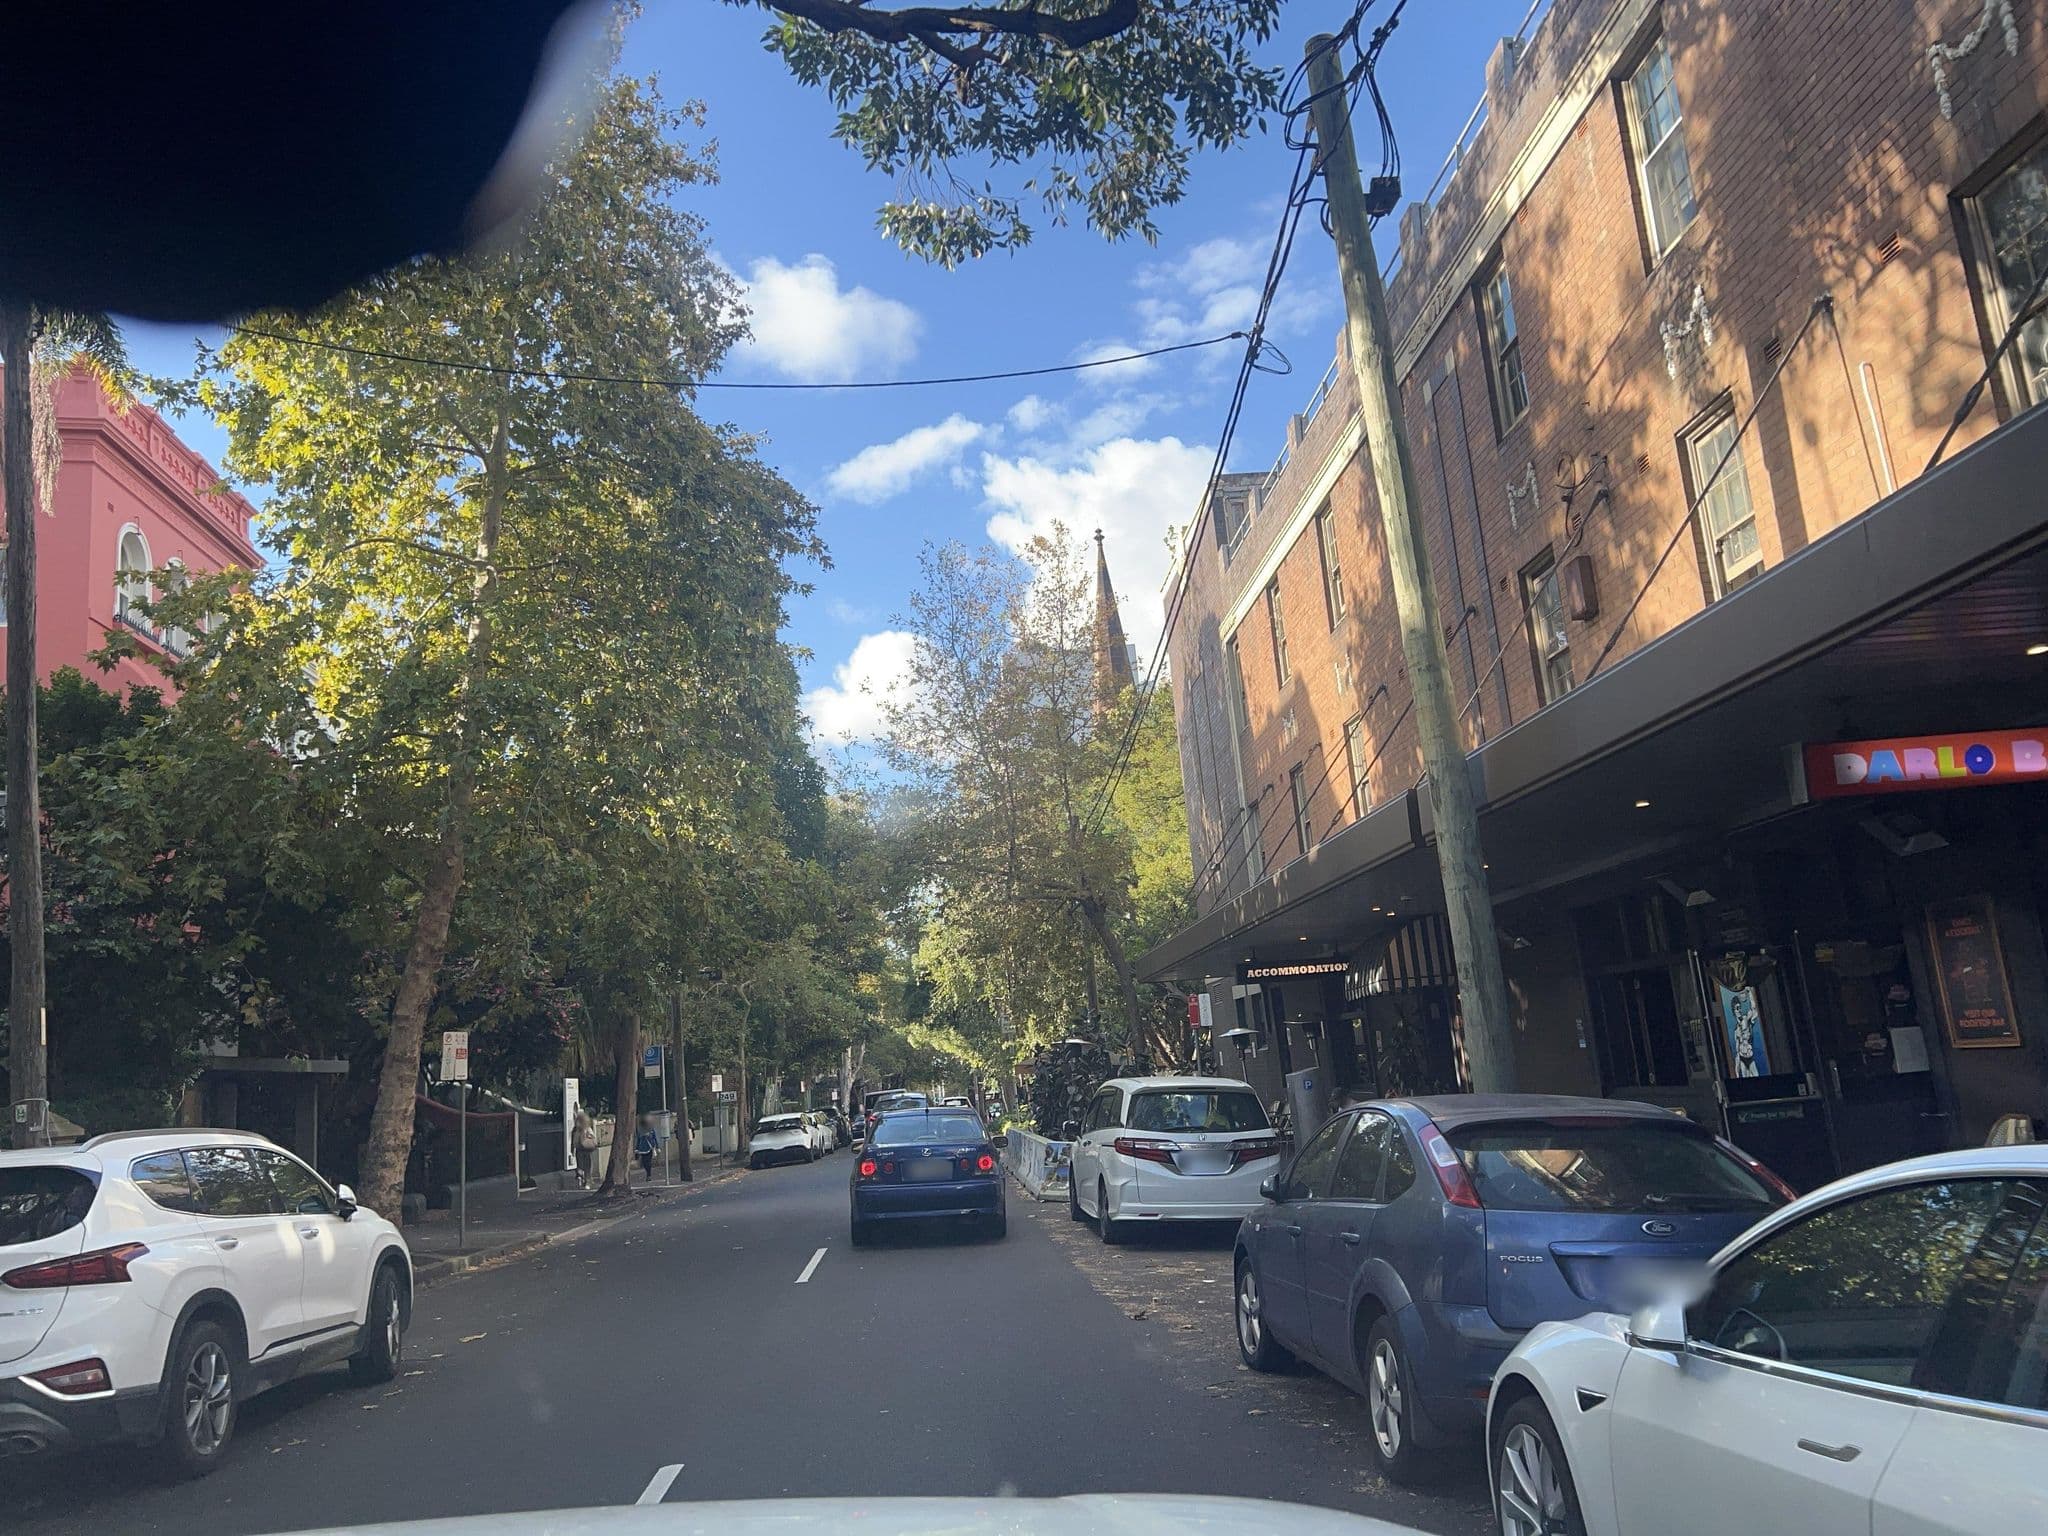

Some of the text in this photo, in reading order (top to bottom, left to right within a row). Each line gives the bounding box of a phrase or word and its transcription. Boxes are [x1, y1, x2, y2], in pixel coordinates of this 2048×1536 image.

[1833, 742, 1997, 785] DARLO
[1304, 1080, 1312, 1089] P
[1499, 1255, 1545, 1263] FOCUS
